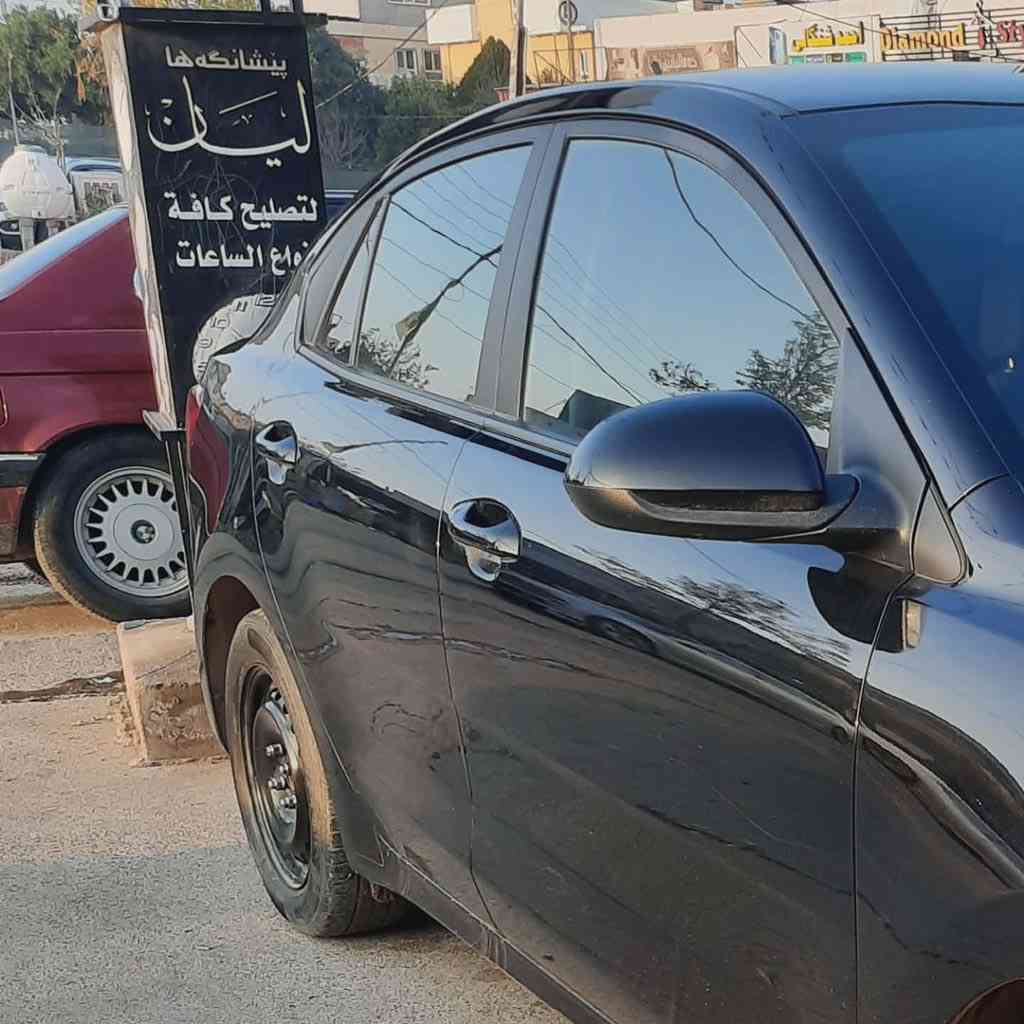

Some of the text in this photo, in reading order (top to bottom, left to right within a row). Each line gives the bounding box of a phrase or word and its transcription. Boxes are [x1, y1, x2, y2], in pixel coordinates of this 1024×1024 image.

[880, 23, 966, 50] Diamond
[164, 191, 318, 230] لتصليح كافة
[175, 240, 264, 268] الساعات
